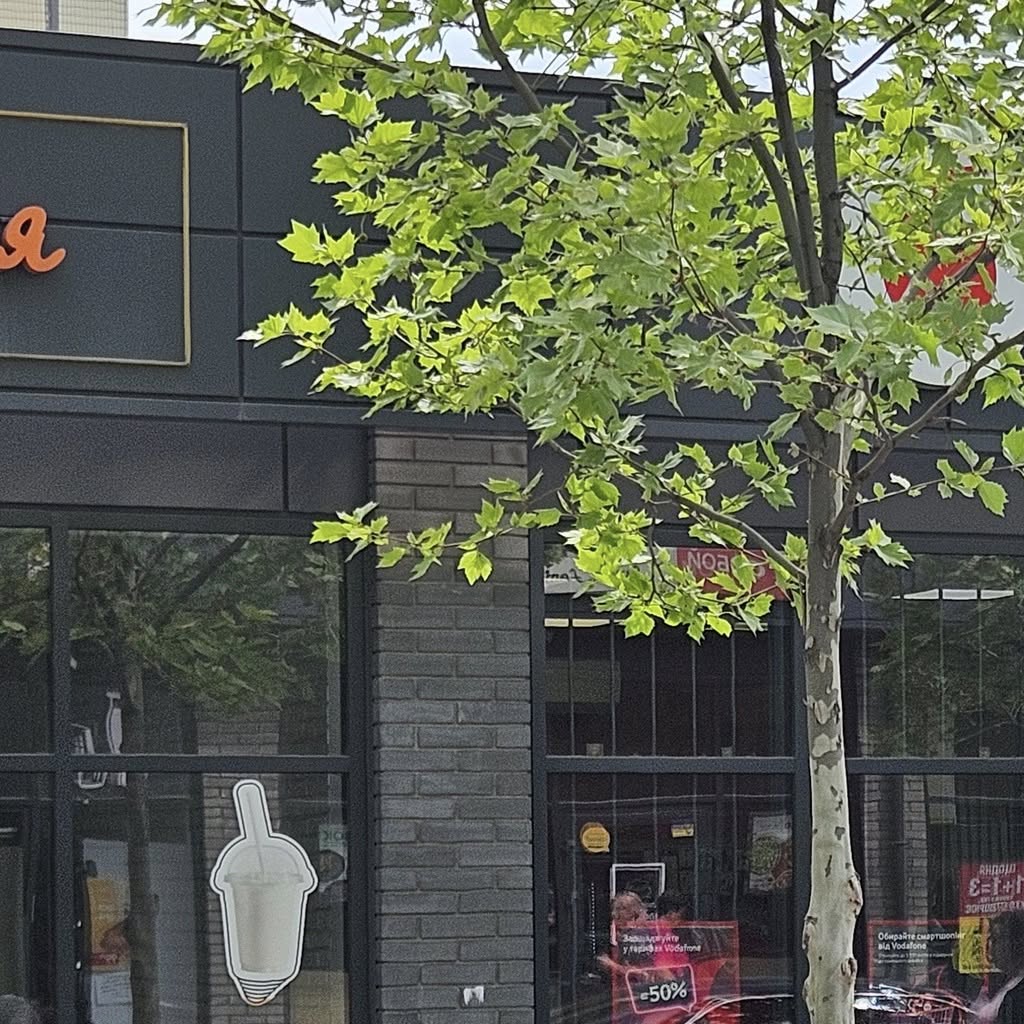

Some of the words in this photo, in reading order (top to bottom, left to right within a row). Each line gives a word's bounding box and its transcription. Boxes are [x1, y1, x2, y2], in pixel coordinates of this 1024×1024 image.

[878, 932, 916, 942] Обирайте
[878, 942, 891, 951] від
[892, 941, 927, 951] Vodafone
